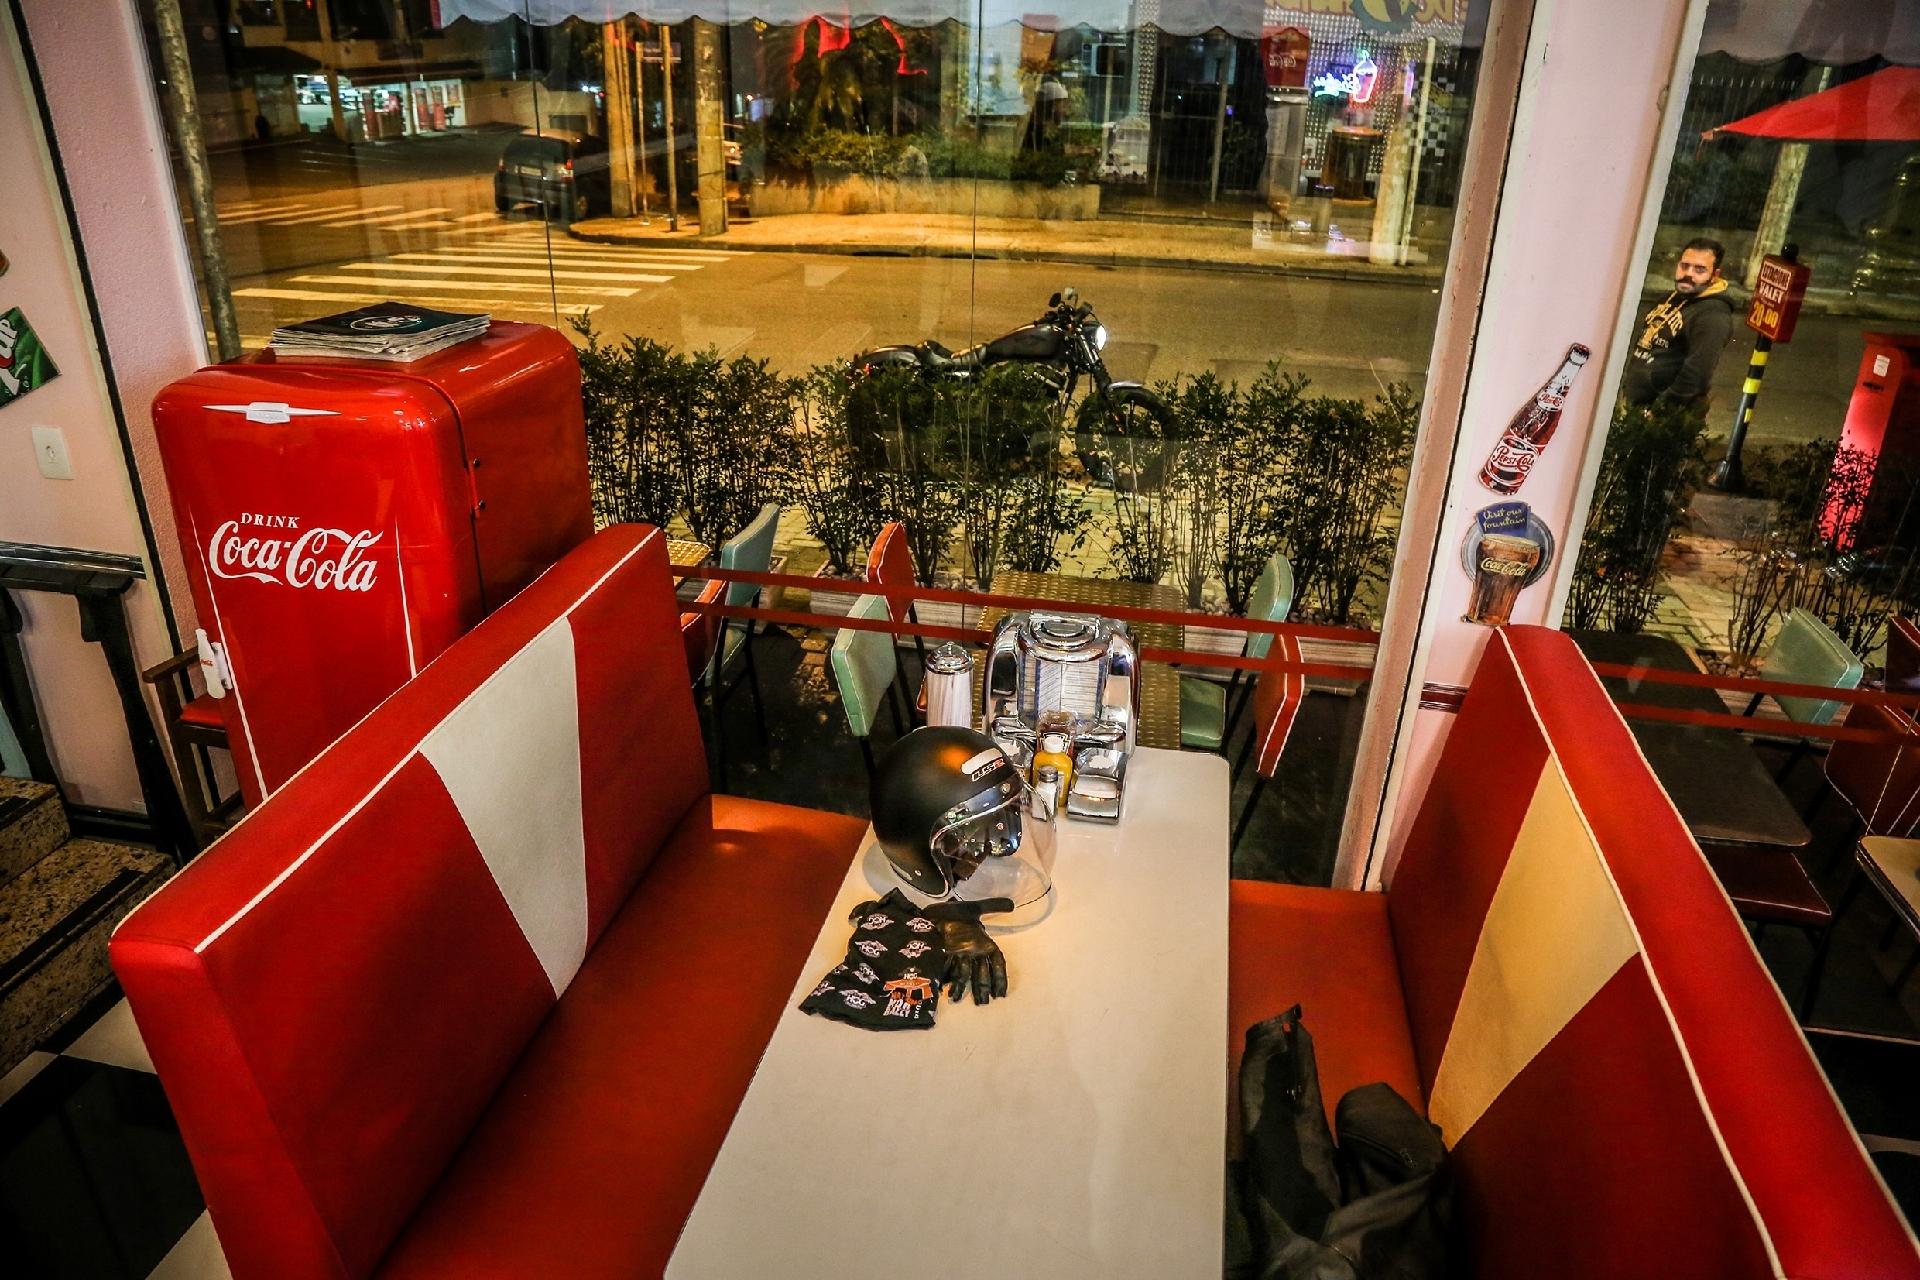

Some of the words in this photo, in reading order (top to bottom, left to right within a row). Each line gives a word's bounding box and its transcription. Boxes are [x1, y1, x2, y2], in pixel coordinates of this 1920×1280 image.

[1759, 281, 1785, 304] VALET
[241, 512, 299, 528] DRINK
[1483, 507, 1505, 520] Visit
[1506, 508, 1522, 517] our
[1483, 515, 1525, 531] fountain
[209, 520, 384, 592] Coca-Cola
